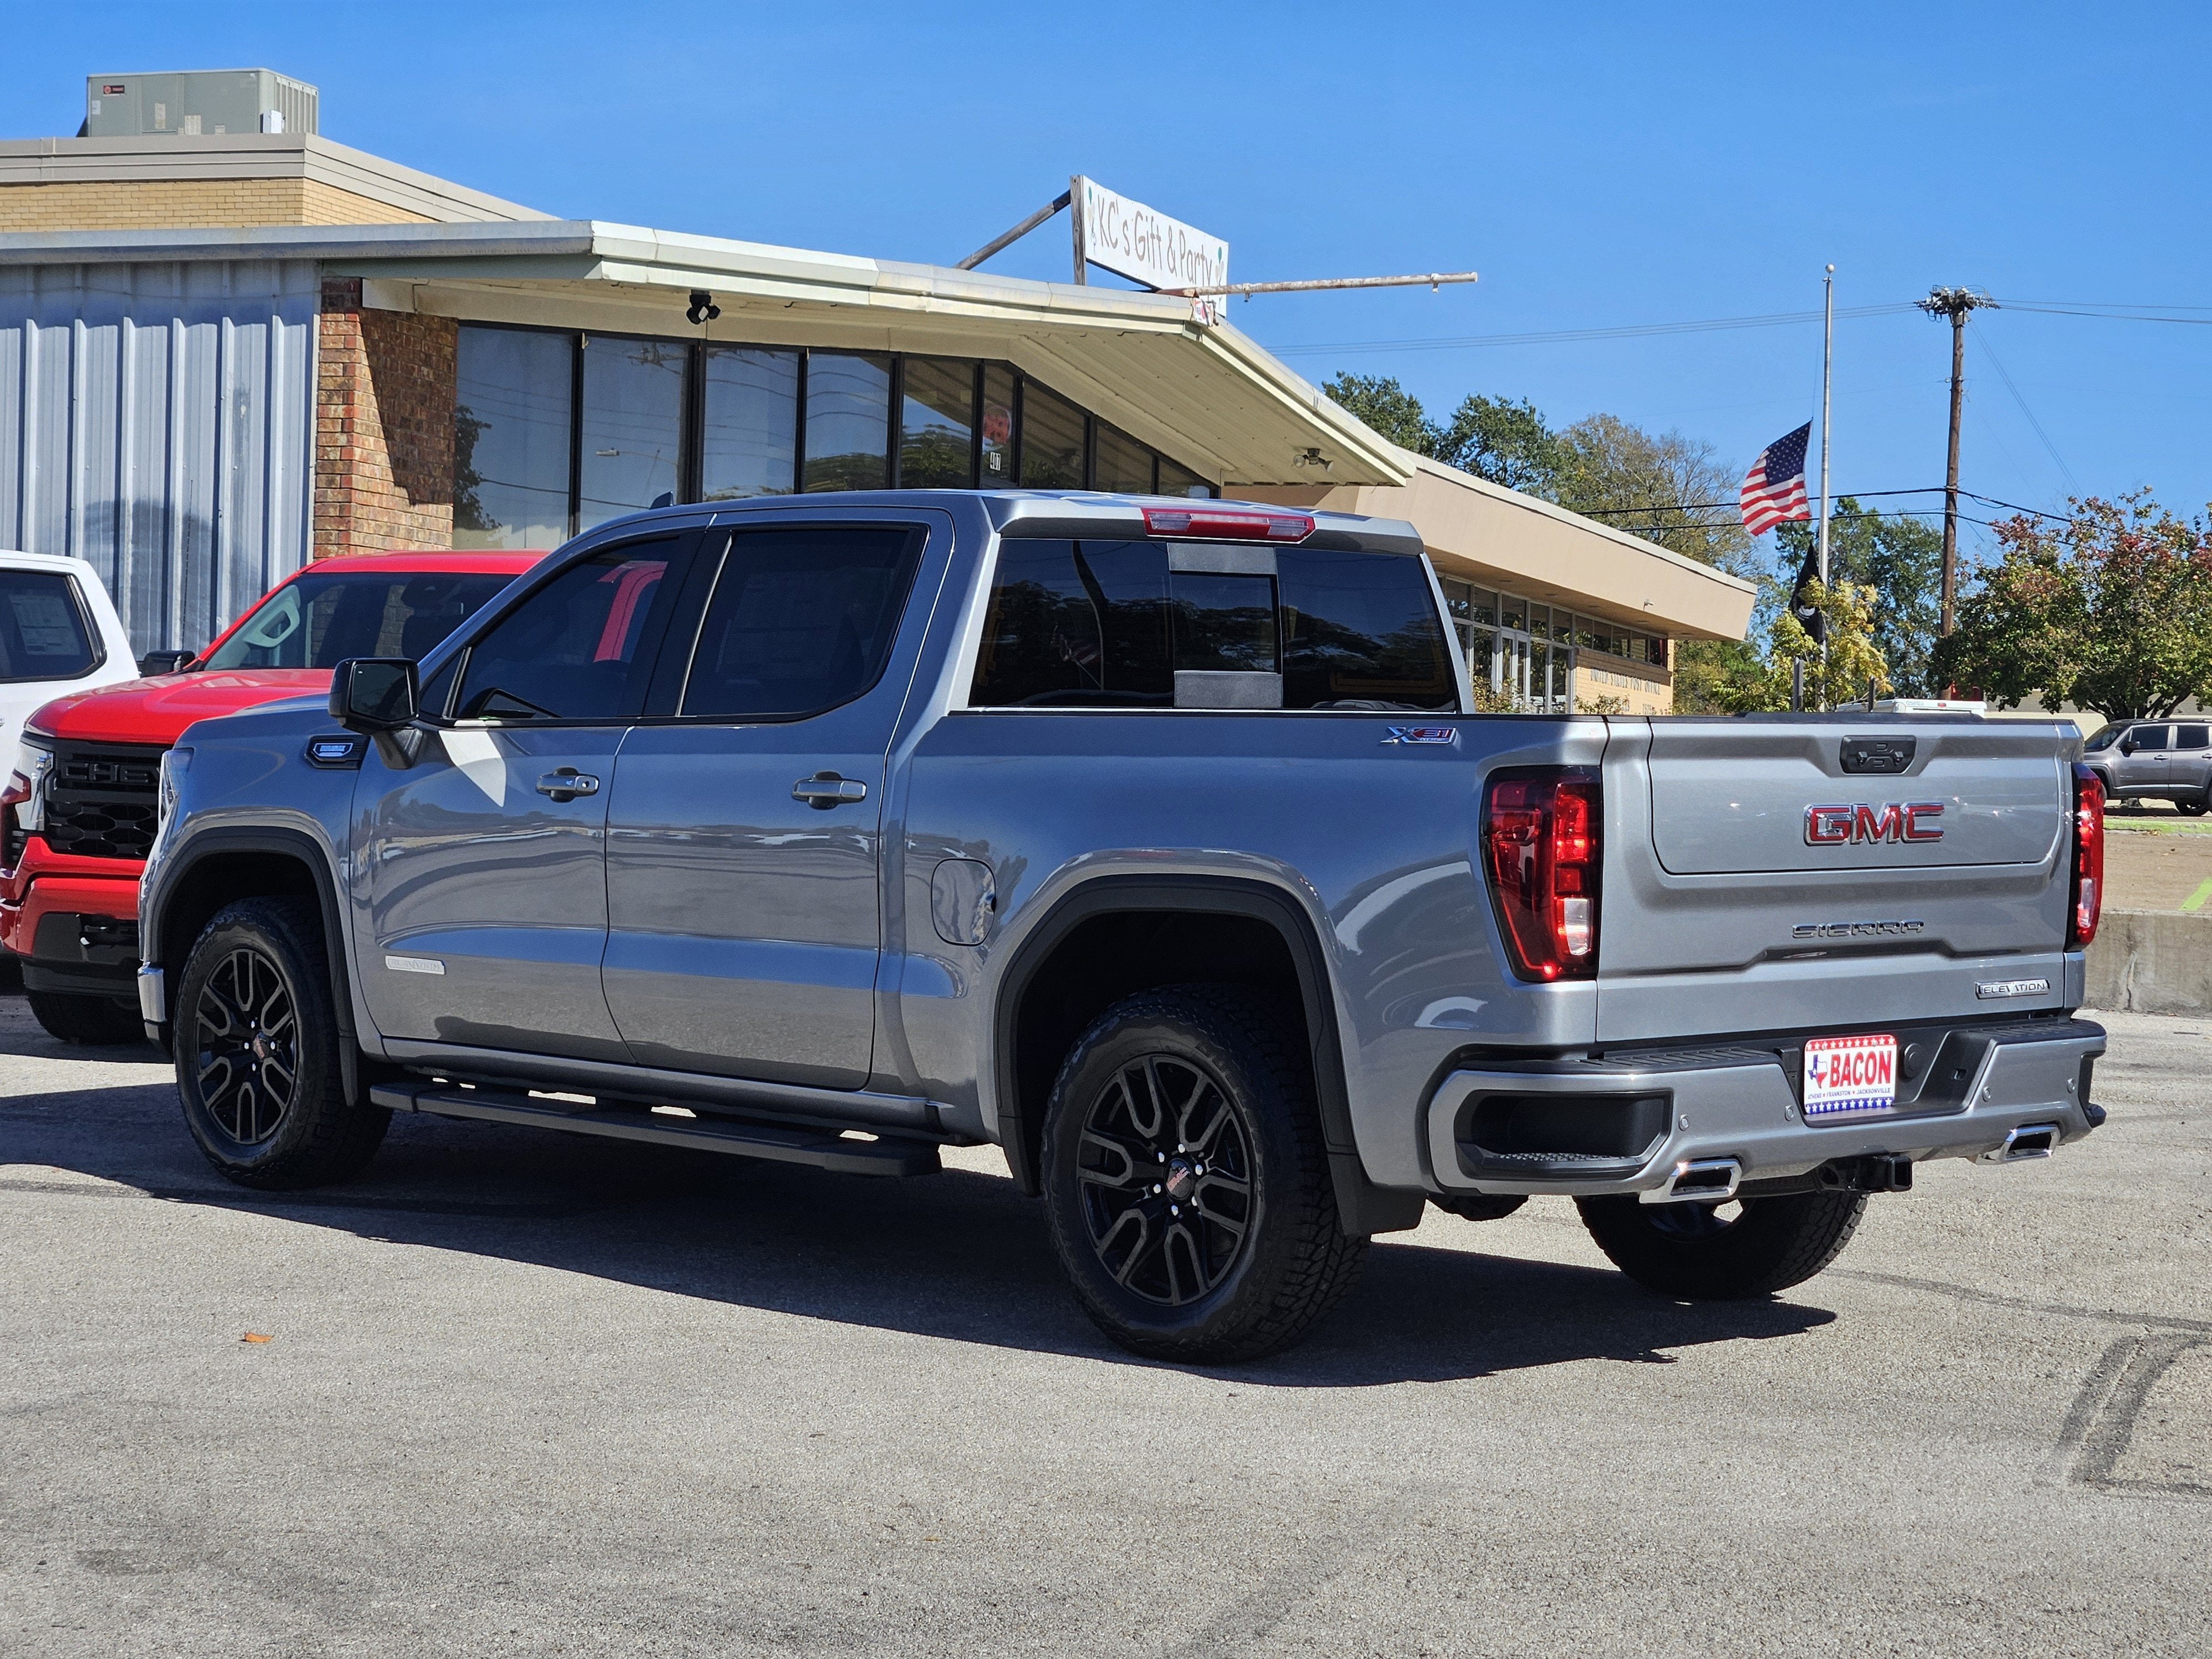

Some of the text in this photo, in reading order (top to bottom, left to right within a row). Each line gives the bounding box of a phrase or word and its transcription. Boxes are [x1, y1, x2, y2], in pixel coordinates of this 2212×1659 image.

[1098, 194, 1212, 302] KC's Gift & Party
[1803, 802, 1945, 846] GMC
[1792, 920, 1924, 938] SIERRA
[390, 958, 441, 971] ELEVATION
[1983, 983, 2046, 994] ELEVATION
[1829, 1050, 1892, 1088] BACON
[1166, 1166, 1190, 1191] GMC
